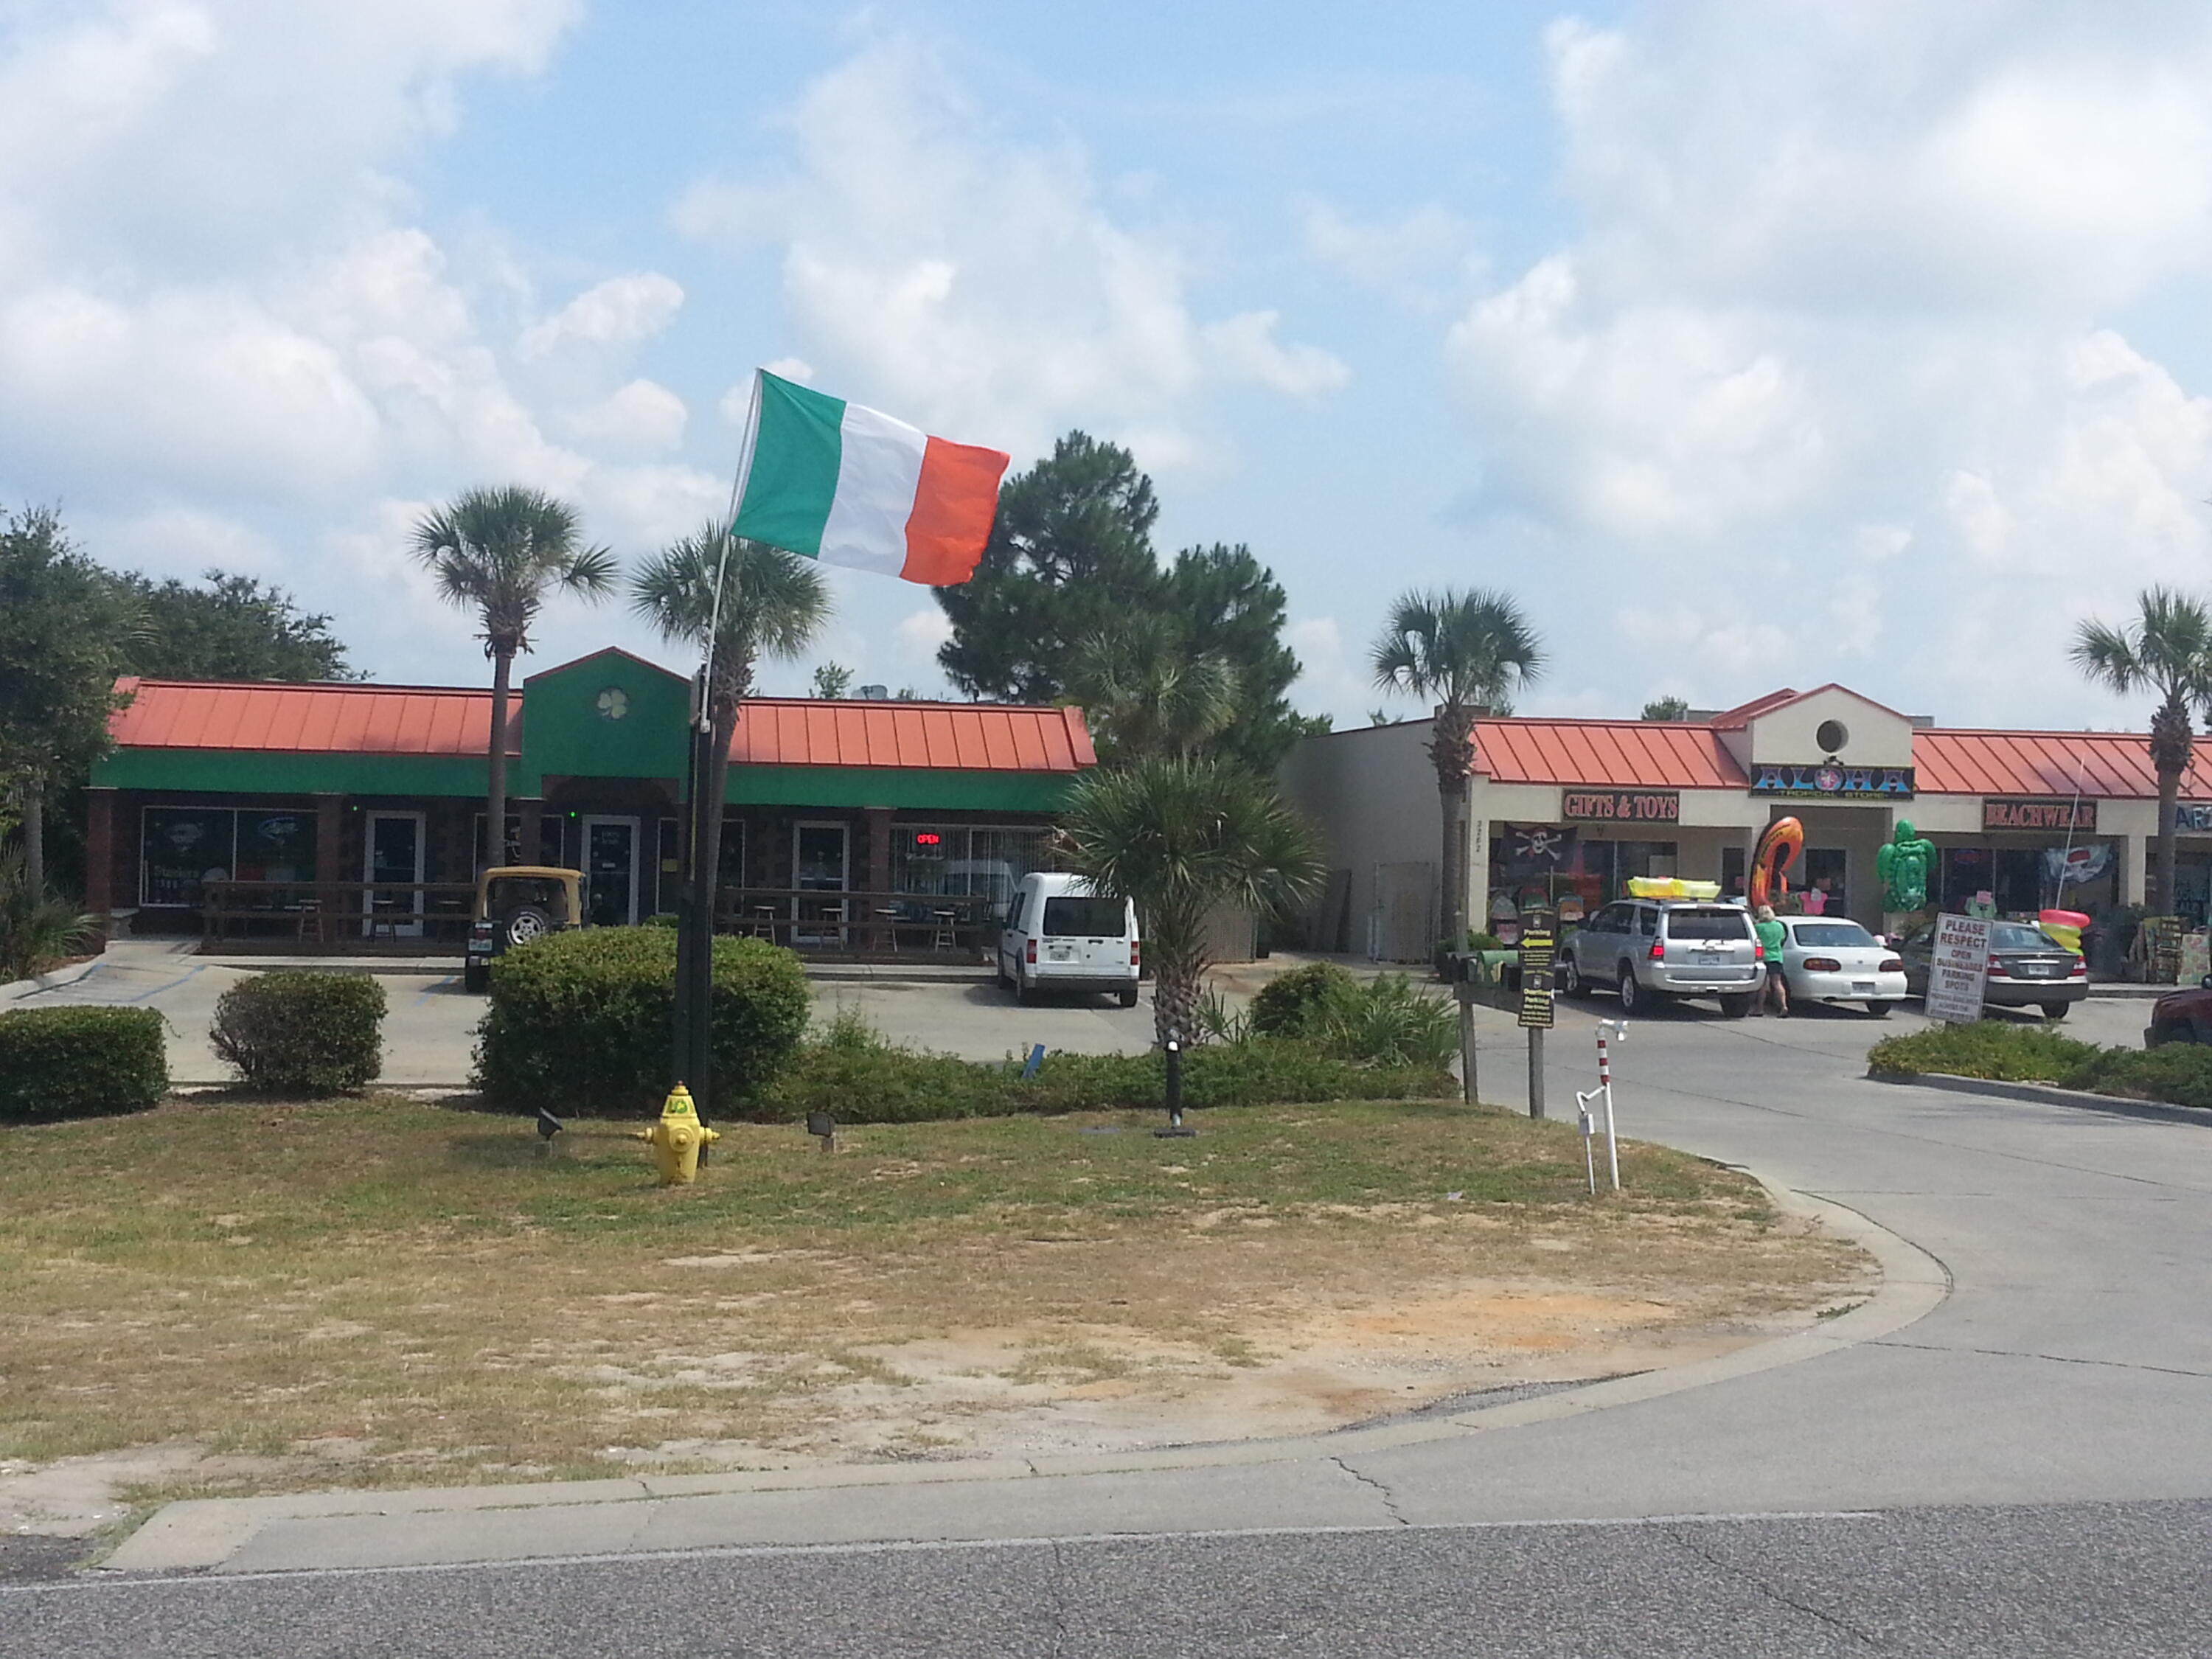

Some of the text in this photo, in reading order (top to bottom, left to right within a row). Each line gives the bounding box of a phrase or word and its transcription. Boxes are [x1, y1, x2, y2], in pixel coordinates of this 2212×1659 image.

[1565, 794, 1678, 818] GIFTS & TOYS
[1986, 804, 2094, 827] BEACHWEAR
[917, 834, 939, 844] OPEN
[1523, 929, 1551, 937] Parking
[1945, 920, 1985, 935] PLEASE
[1940, 933, 1987, 948] RESPECT
[1951, 950, 1972, 959] OPEN
[1941, 969, 1975, 981] PARKING
[1944, 980, 1969, 992] SPOTS
